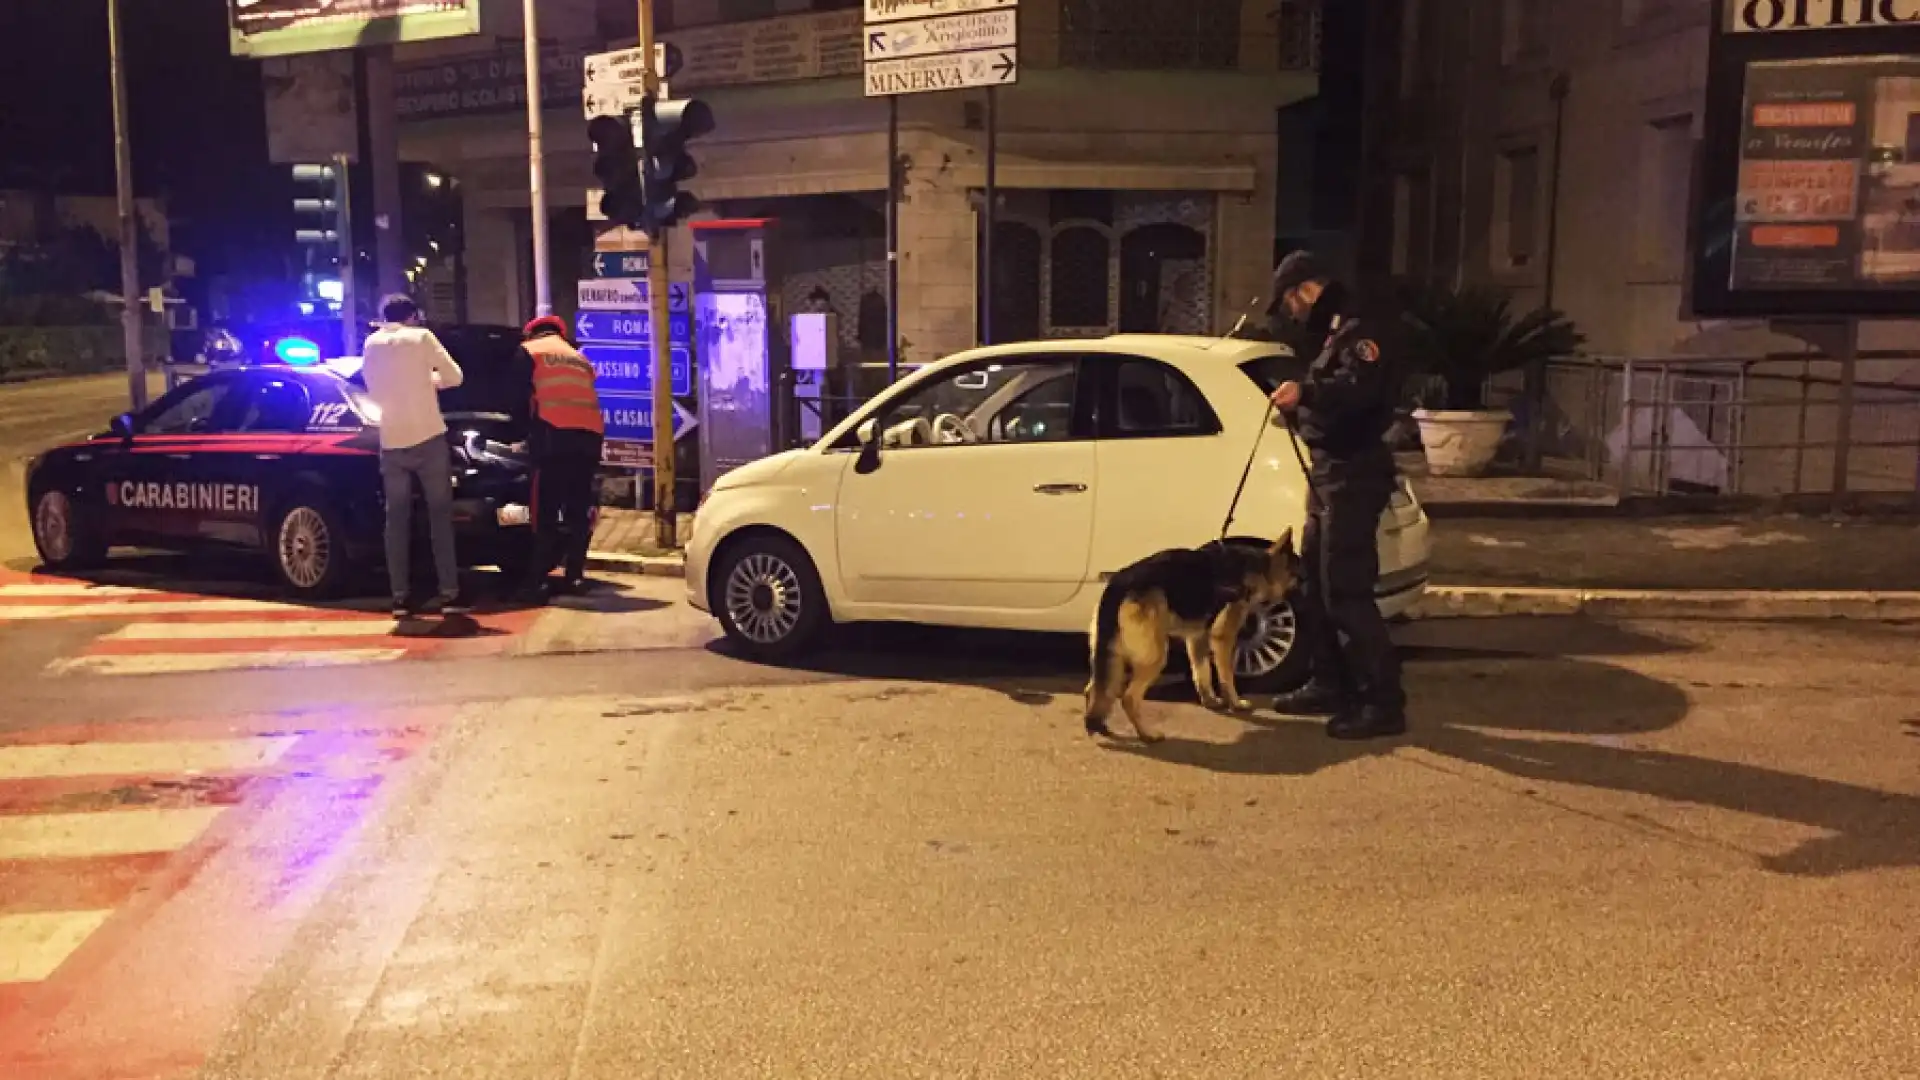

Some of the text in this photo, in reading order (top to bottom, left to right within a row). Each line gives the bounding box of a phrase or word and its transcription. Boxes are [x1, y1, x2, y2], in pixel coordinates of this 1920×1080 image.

[869, 67, 964, 92] MINERVA
[592, 361, 640, 379] ASSINO
[309, 402, 348, 425] 112
[614, 409, 653, 427] CASAL
[119, 480, 259, 512] CARABINIERI
